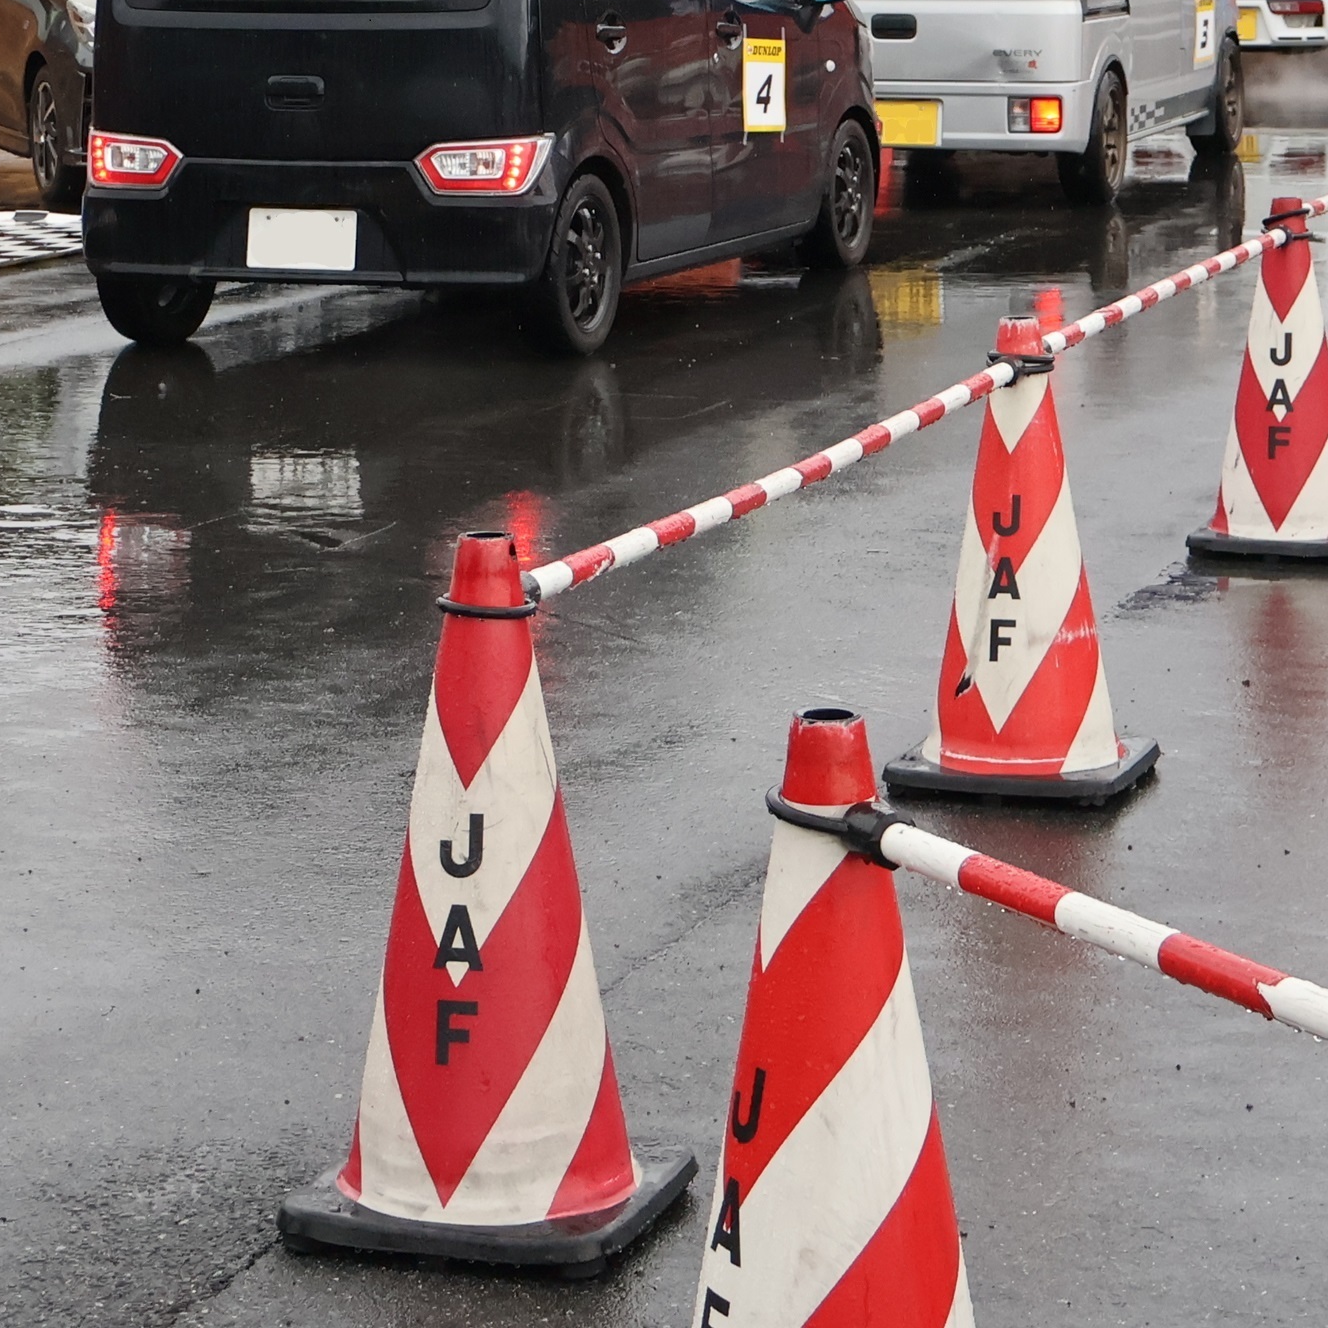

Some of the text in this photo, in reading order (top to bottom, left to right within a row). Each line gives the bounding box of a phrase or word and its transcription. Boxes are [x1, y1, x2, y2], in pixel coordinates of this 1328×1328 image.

[753, 45, 782, 56] DUNLOP
[756, 74, 773, 113] 4
[1266, 332, 1294, 460] JAF
[988, 494, 1021, 663] JAF
[433, 813, 484, 1066] JAF
